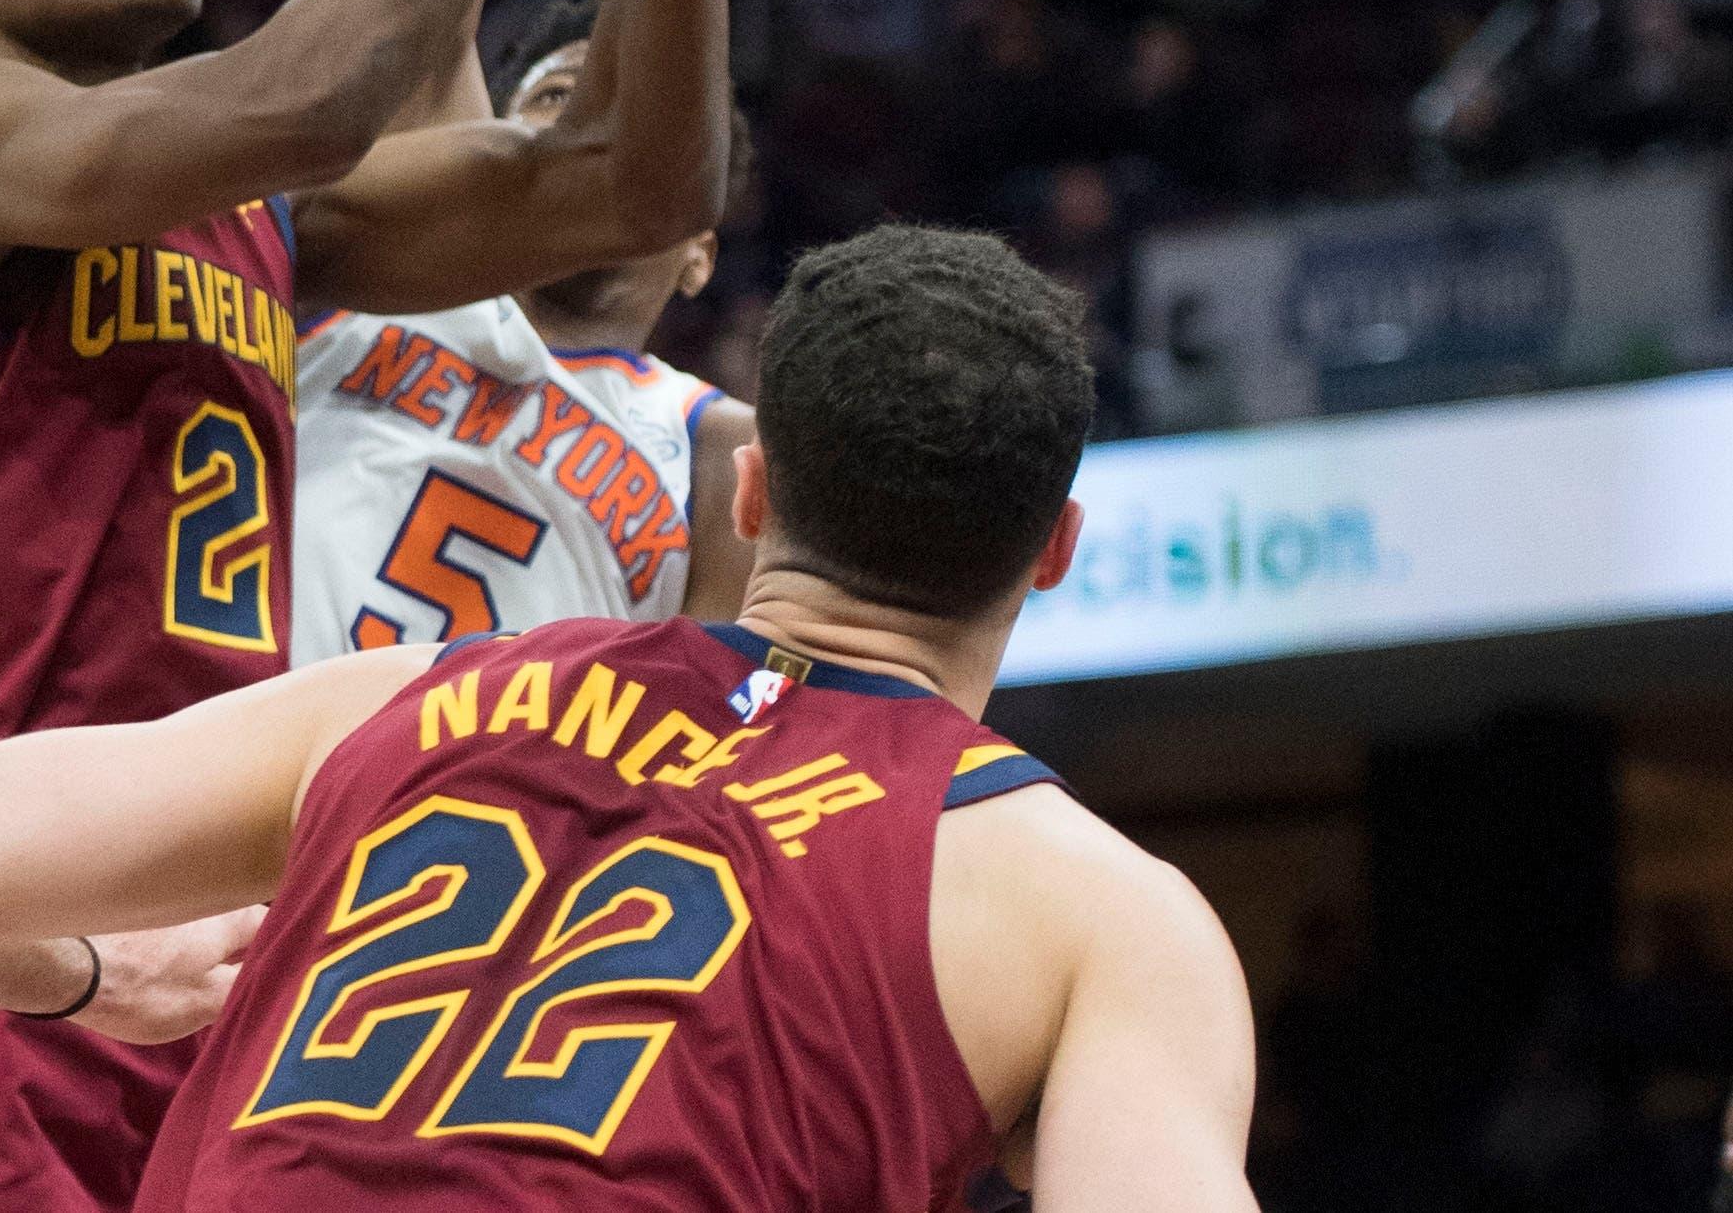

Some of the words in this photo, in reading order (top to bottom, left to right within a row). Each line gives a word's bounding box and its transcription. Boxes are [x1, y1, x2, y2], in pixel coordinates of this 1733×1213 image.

[71, 246, 297, 421] CLEVELAN
[164, 400, 278, 653] 2
[338, 324, 536, 447] NEW
[515, 381, 690, 603] YORK
[350, 466, 550, 653] 5
[420, 661, 774, 788] NANCE
[722, 753, 886, 858] JR.
[230, 794, 753, 1156] 22
